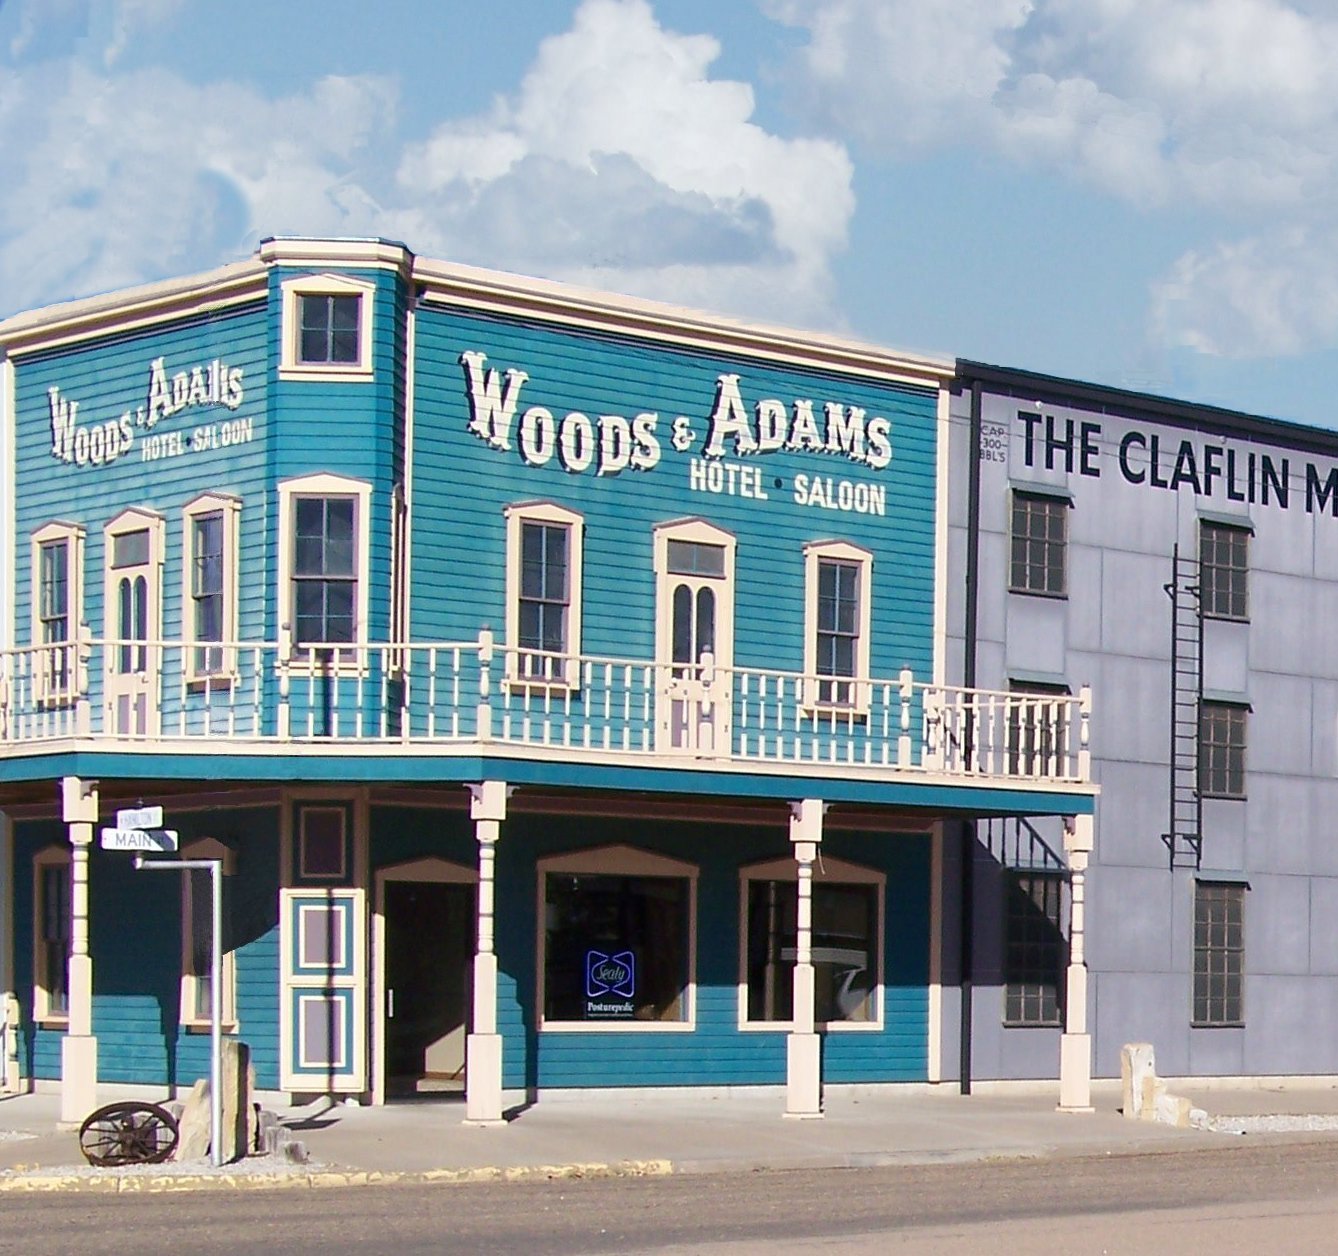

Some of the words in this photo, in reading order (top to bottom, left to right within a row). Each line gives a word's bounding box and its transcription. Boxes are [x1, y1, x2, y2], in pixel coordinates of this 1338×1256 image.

[48, 386, 134, 468] WOODS
[142, 431, 184, 462] HOTEL
[193, 417, 253, 451] SALOON
[461, 350, 661, 477] WOODS
[671, 416, 696, 452] &
[702, 374, 892, 470] ADAMS
[689, 458, 769, 501] HOTEL
[794, 473, 886, 516] SALOON
[1017, 410, 1102, 477] THE
[1118, 430, 1289, 510] CLAFLIN
[116, 832, 152, 847] MAIN
[596, 964, 625, 983] Sealy
